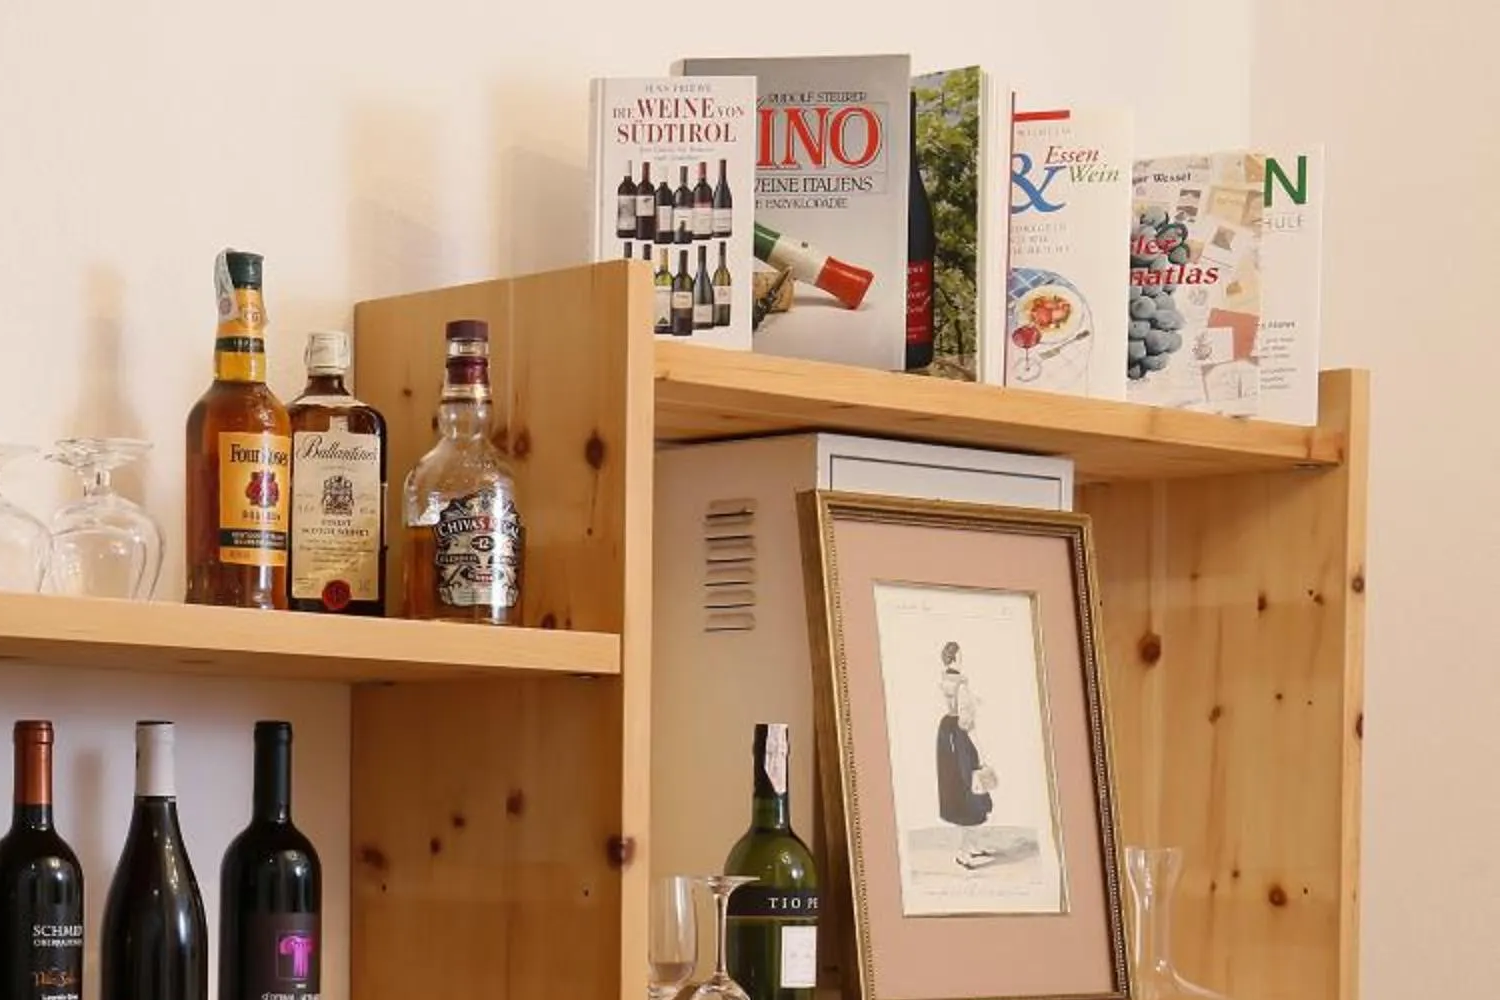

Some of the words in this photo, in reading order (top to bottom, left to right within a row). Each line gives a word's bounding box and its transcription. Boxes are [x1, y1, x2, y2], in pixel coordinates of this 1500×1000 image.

[636, 97, 716, 119] WEINE
[617, 120, 737, 144] SÜDTIROL
[756, 105, 883, 169] INO
[1045, 145, 1100, 164] Essen
[1069, 164, 1119, 183] Wein
[802, 176, 874, 194] ITALIENS
[231, 443, 259, 464] Four
[440, 516, 490, 537] CHIVAS
